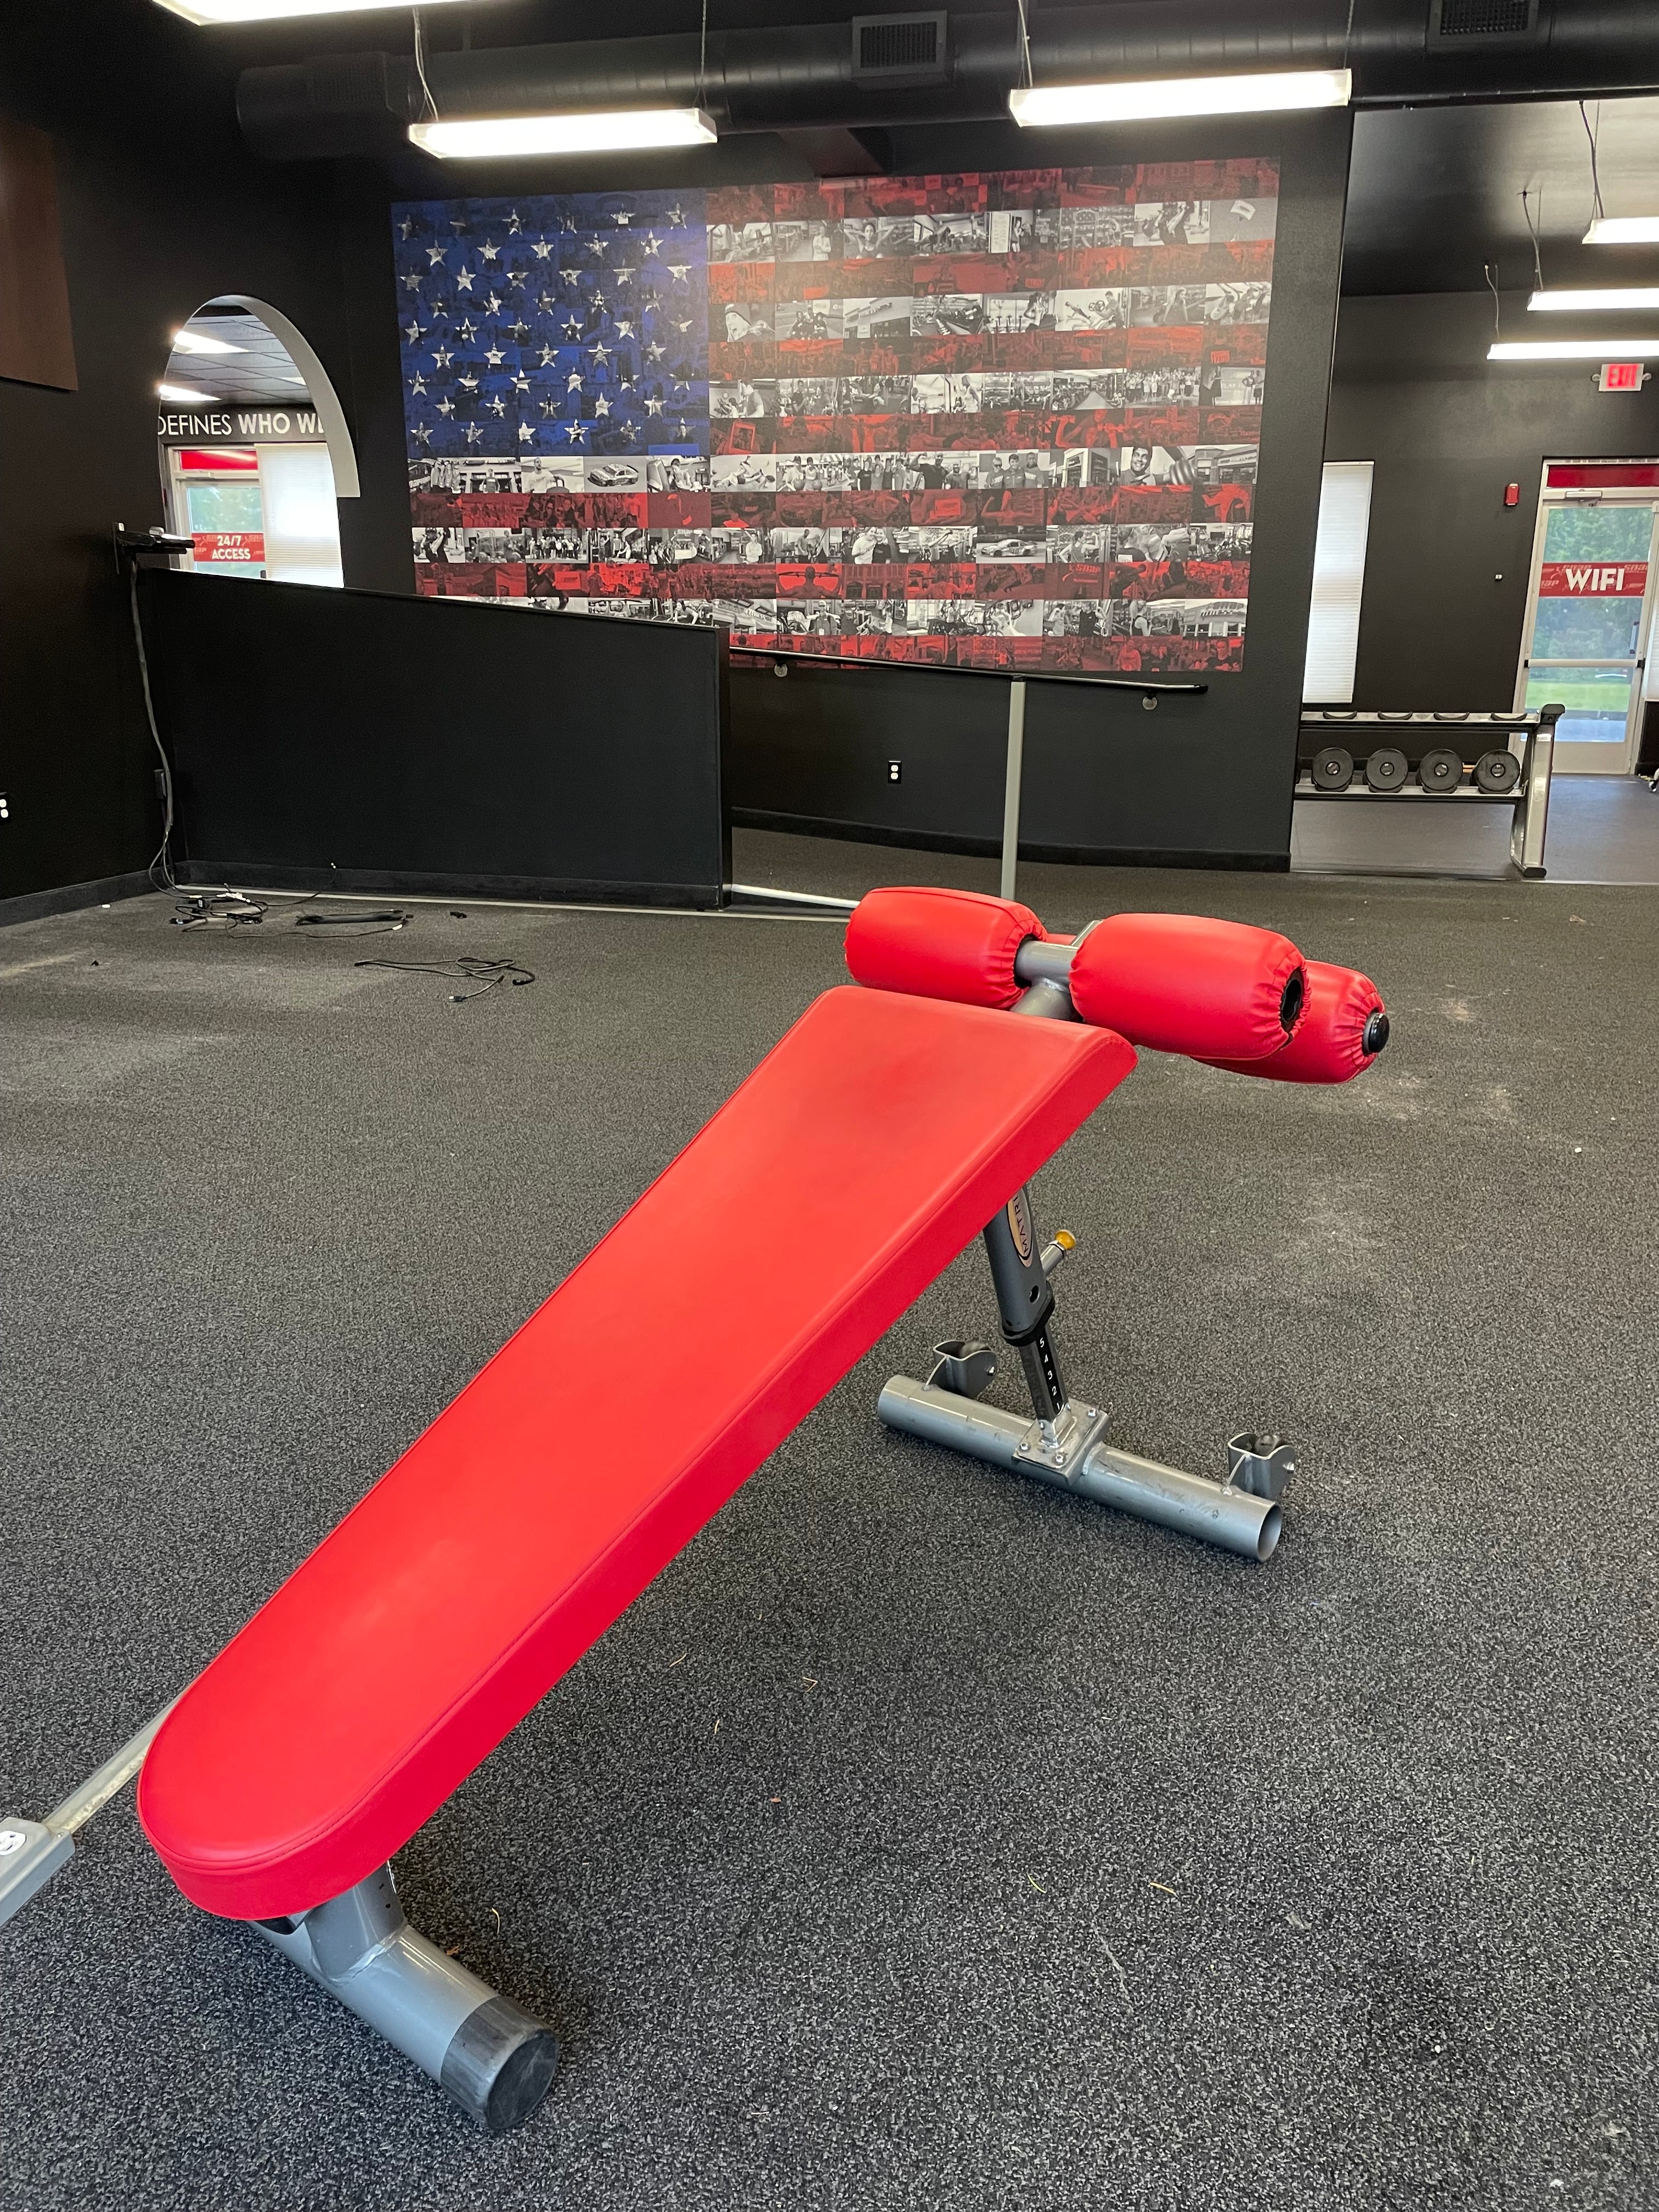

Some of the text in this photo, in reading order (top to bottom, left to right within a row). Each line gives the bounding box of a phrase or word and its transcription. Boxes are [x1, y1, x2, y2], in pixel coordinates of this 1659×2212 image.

[1606, 364, 1639, 388] EXIT
[238, 413, 290, 435] WHO
[217, 535, 242, 546] 24/7
[211, 549, 251, 560] ACCESS
[1565, 568, 1625, 591] WIFI
[1013, 1195, 1030, 1253] MATRI
[1040, 1337, 1045, 1348] 5
[1052, 1386, 1057, 1396] 2
